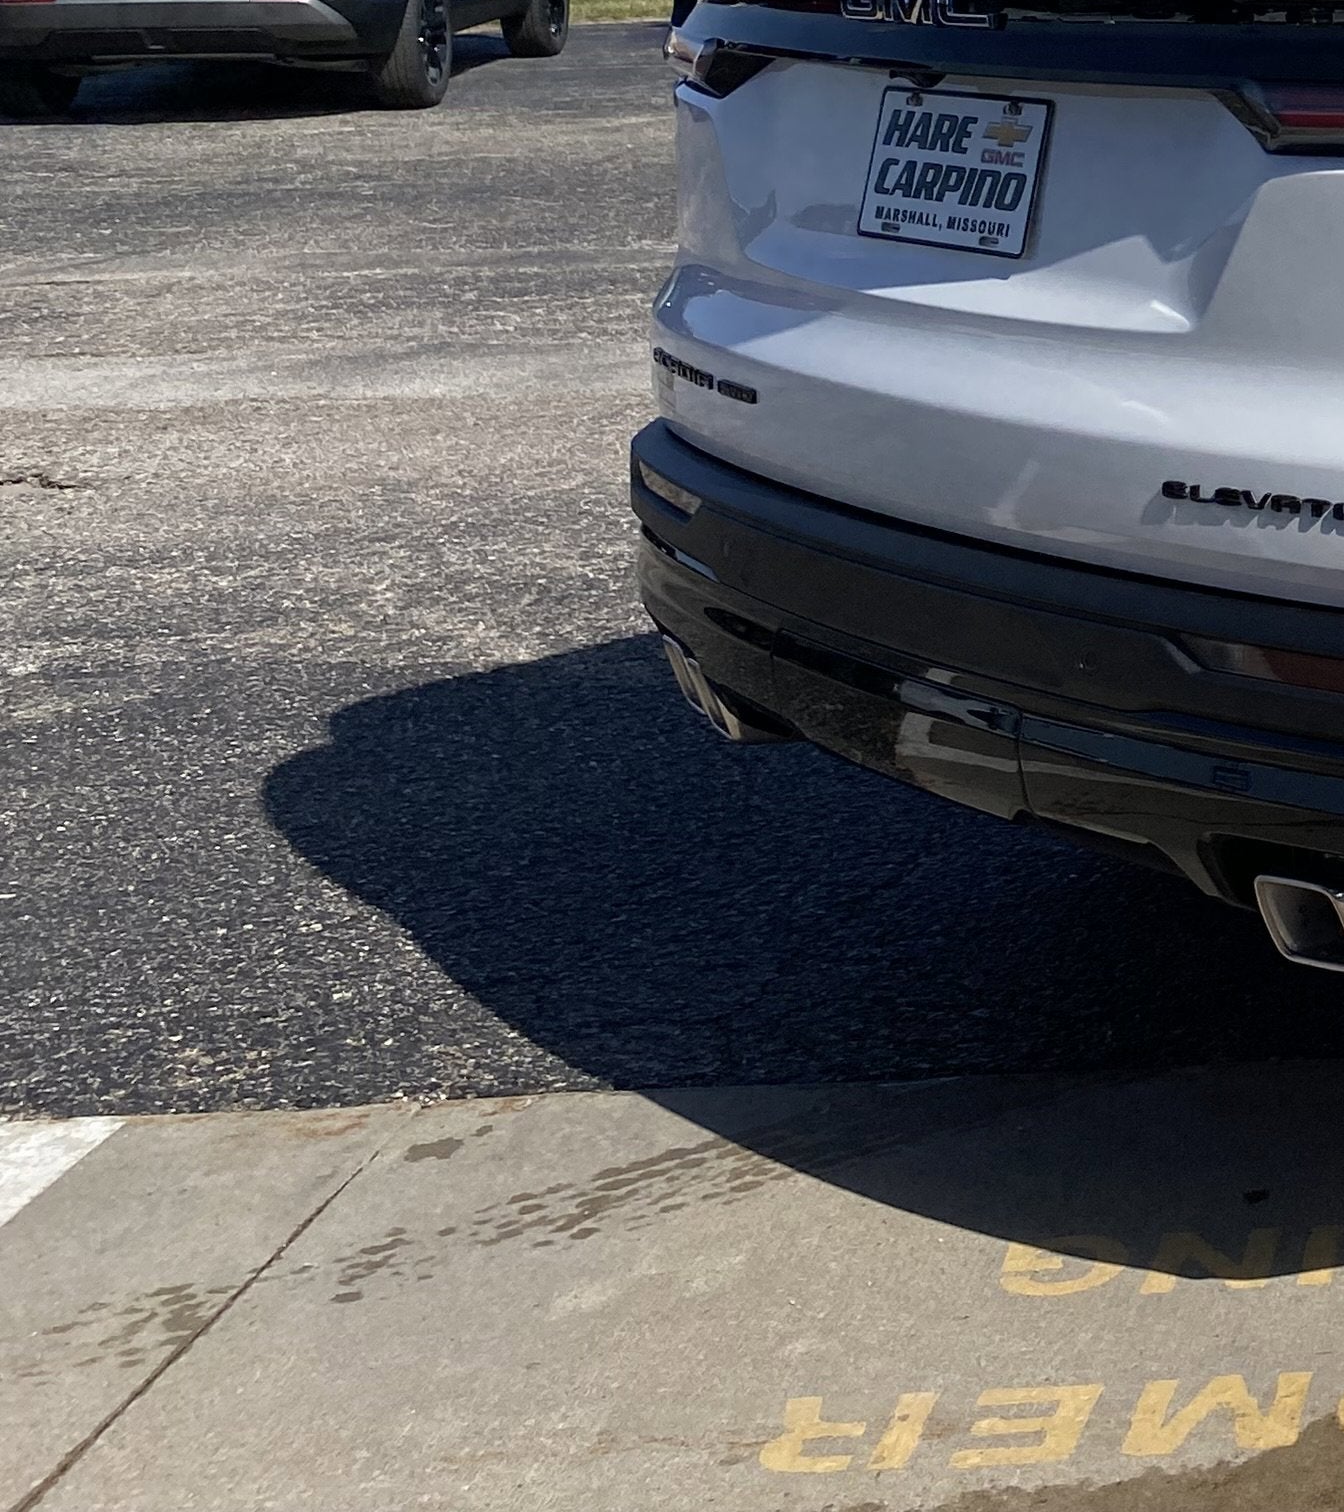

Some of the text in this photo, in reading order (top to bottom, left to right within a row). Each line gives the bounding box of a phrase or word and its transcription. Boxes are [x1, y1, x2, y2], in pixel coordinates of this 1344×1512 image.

[882, 109, 978, 154] HARE
[980, 148, 1026, 168] GMC
[874, 157, 1027, 212] CARPINO
[874, 206, 1011, 238] MARSHALL, MISSOURI
